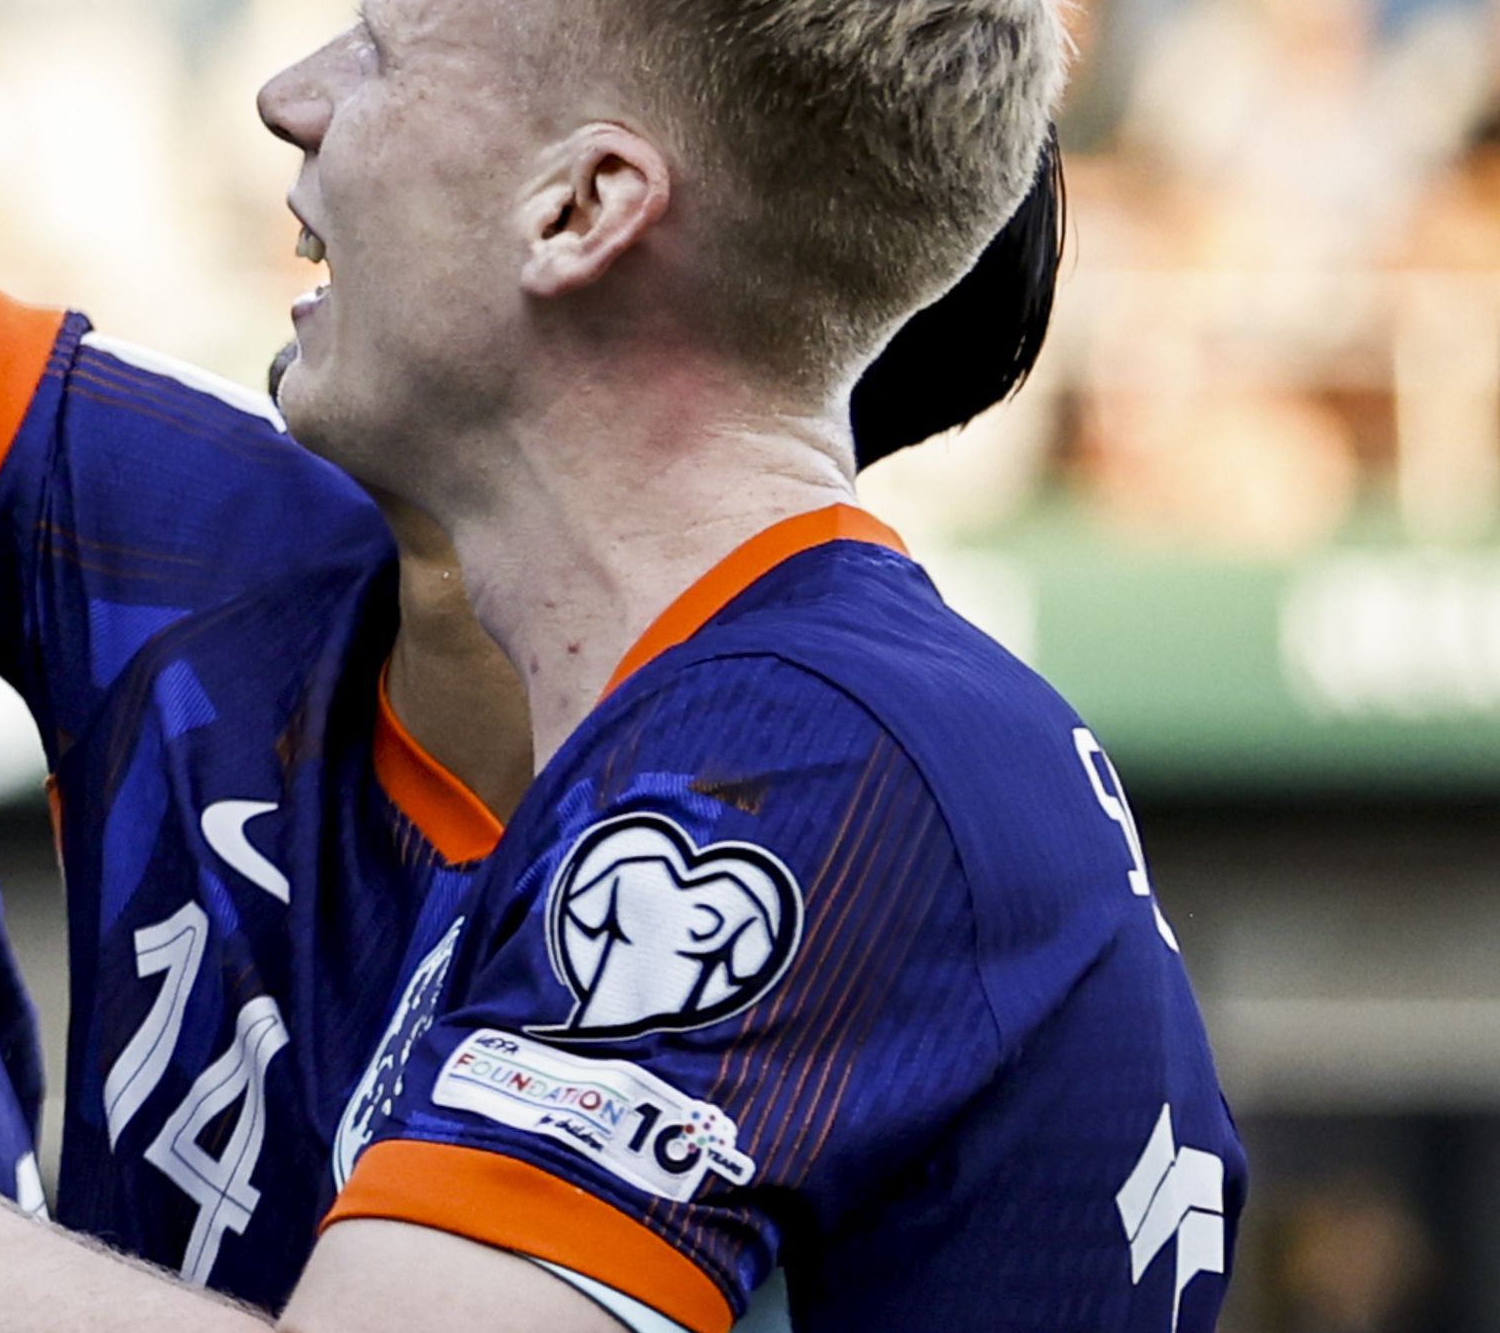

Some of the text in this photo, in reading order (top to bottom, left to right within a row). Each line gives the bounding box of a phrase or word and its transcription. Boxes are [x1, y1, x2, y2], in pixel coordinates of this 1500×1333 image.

[474, 1035, 520, 1055] UEFA
[104, 900, 290, 1289] 14
[453, 1053, 624, 1126] FOUNDATION
[627, 1102, 702, 1175] 10
